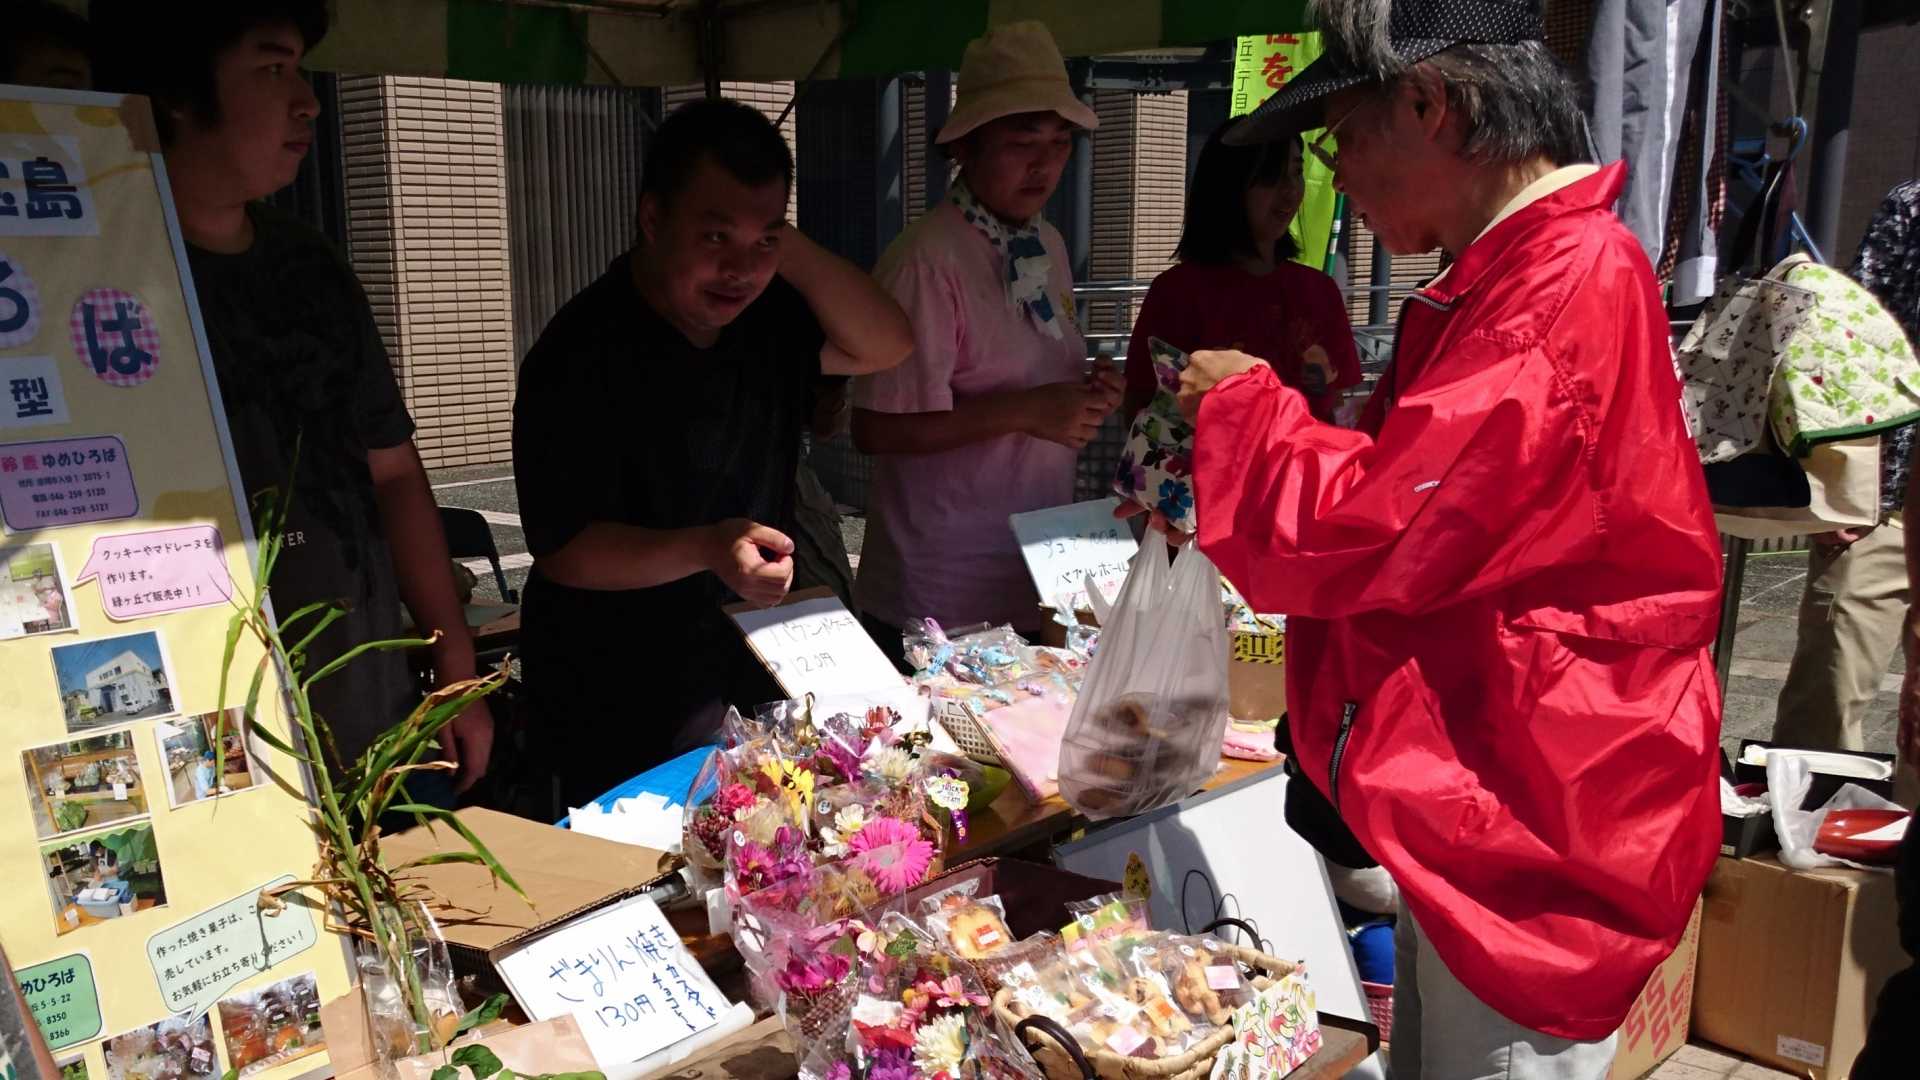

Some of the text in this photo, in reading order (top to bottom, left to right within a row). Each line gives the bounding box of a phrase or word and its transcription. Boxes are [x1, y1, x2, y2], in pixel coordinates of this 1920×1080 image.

[1235, 40, 1252, 116] 丘二丁目
[10, 377, 53, 418] 型
[42, 447, 116, 468] ゆめひろば
[103, 538, 213, 561] クッキーやマドレーヌを
[107, 569, 154, 585] 作ります。
[595, 994, 656, 1027] 130円
